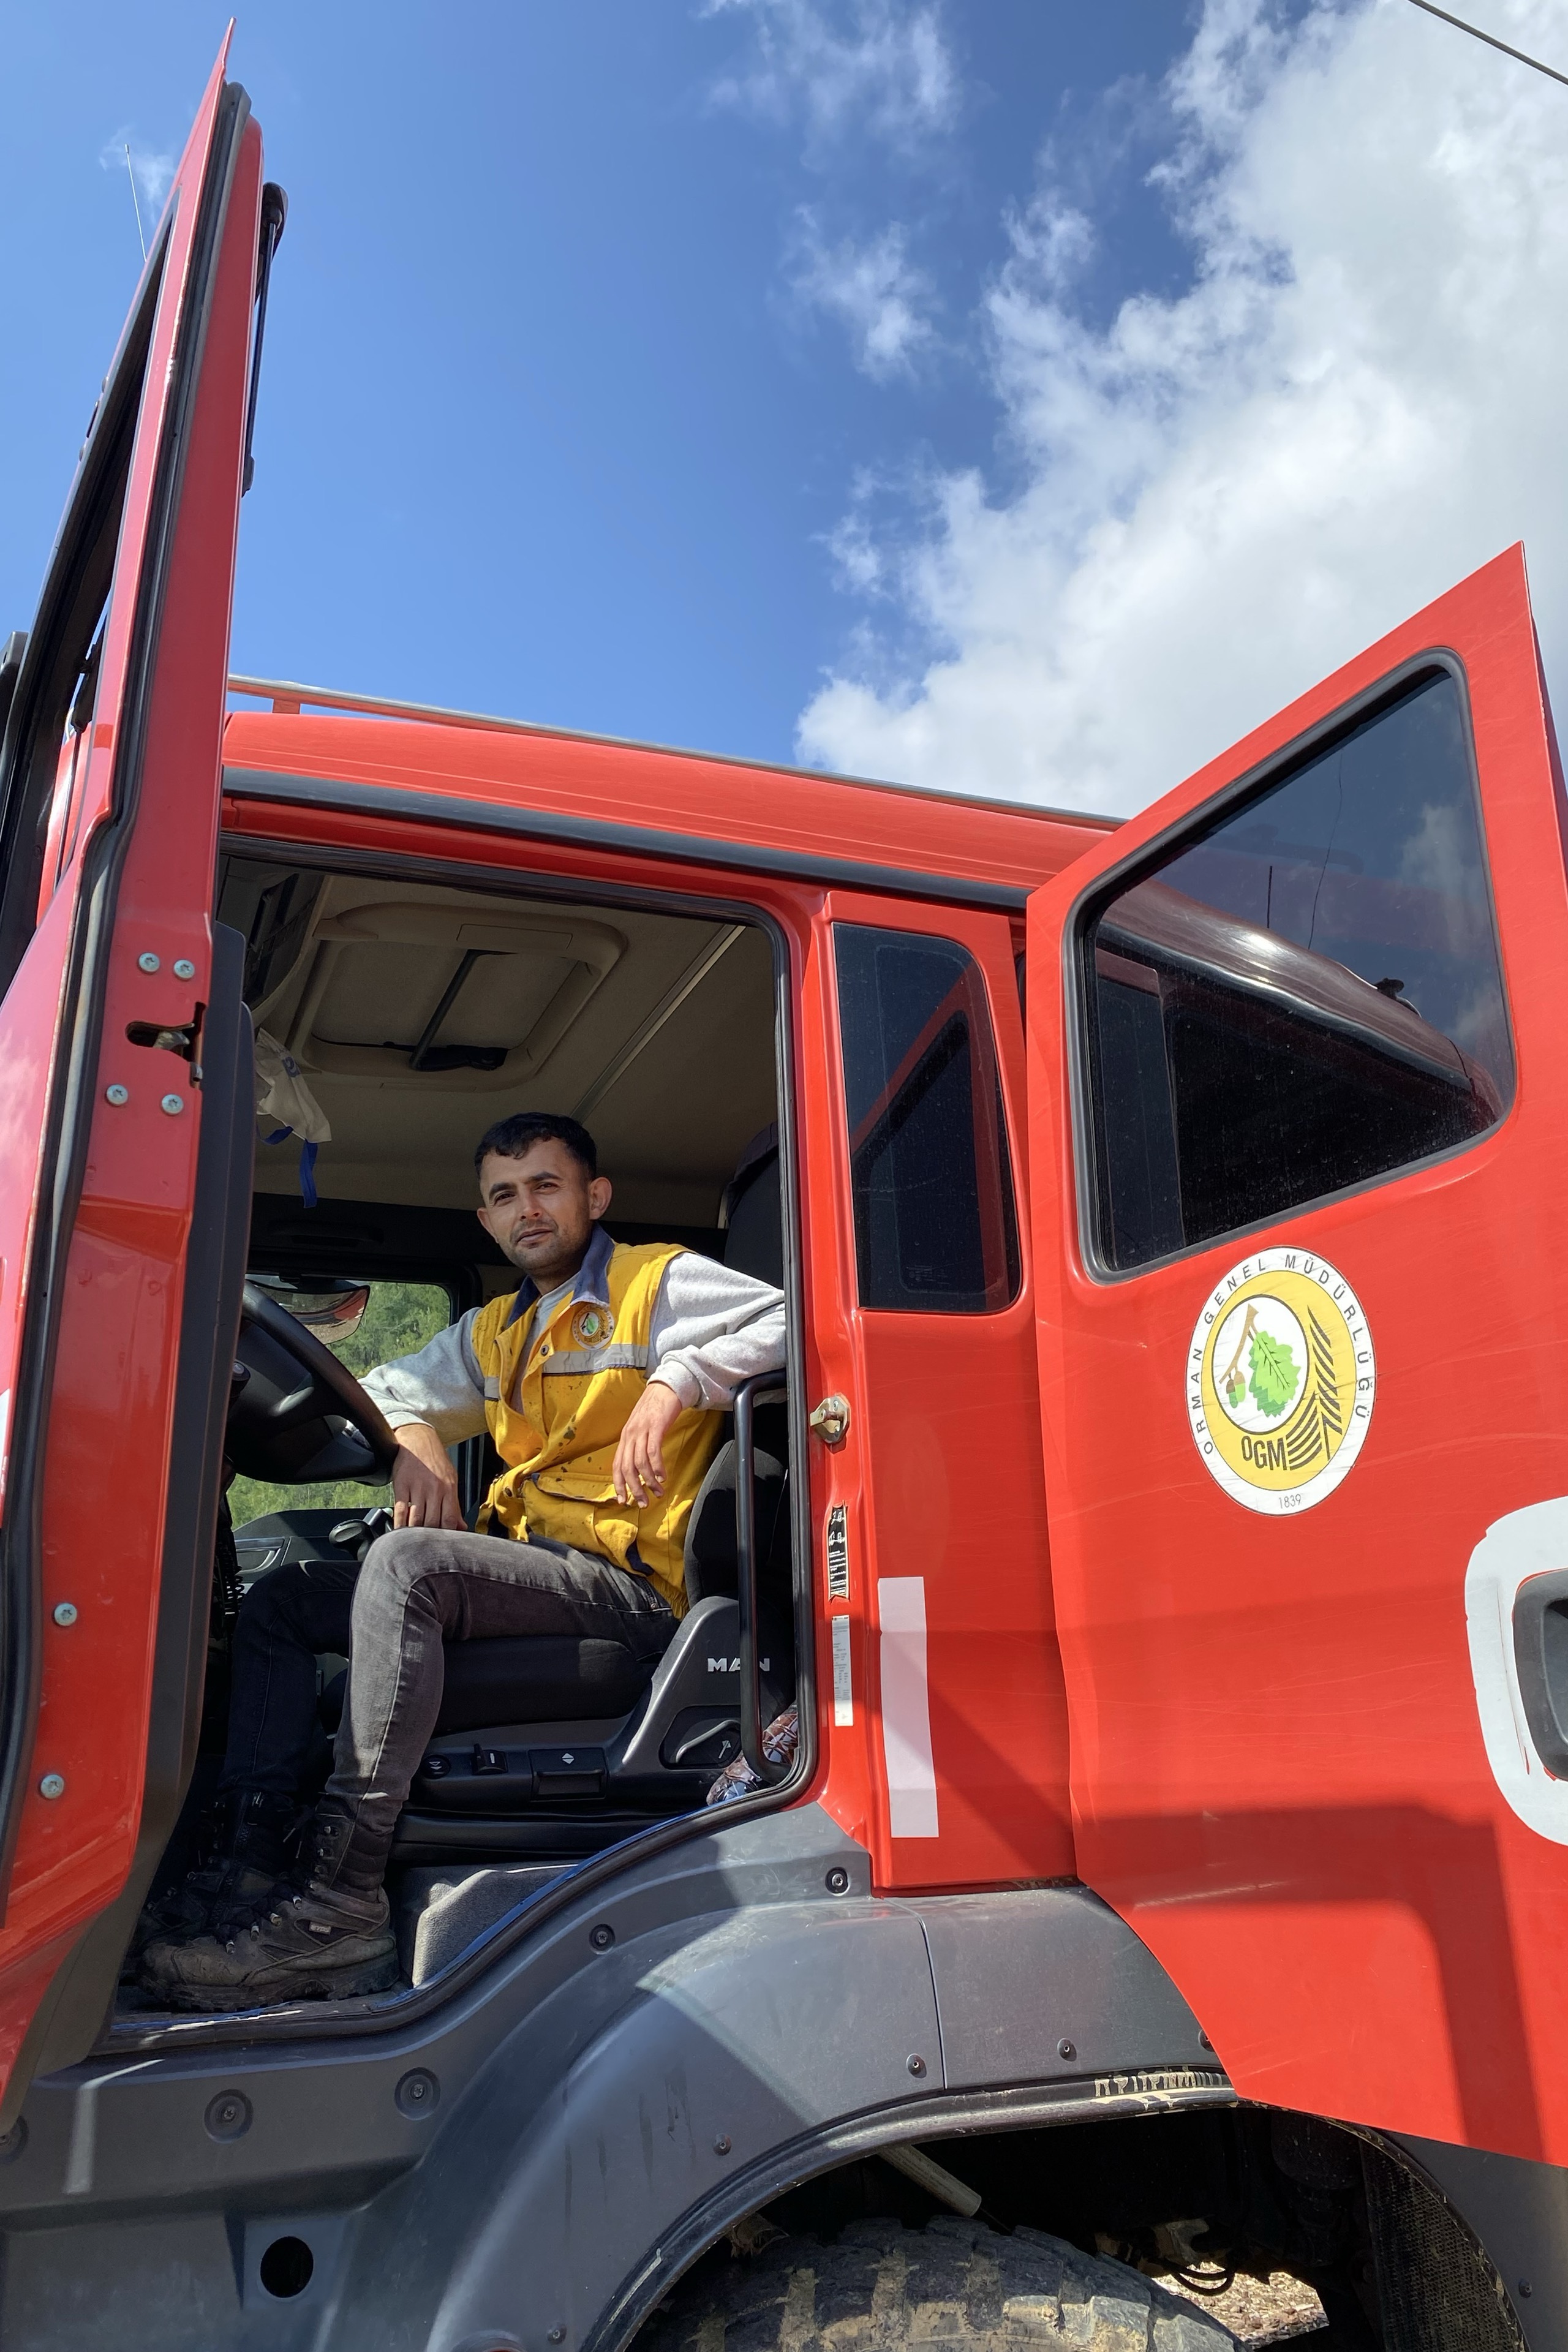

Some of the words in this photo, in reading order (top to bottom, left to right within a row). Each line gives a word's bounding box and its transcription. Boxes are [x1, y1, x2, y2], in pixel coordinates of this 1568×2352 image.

[1191, 1348, 1214, 1455] ORMAN
[1204, 1257, 1267, 1325] GENEL
[1284, 1254, 1374, 1419] MÜDÜRLÜĞÜ
[1241, 1435, 1287, 1471] OGM
[1279, 1493, 1302, 1509] 1839
